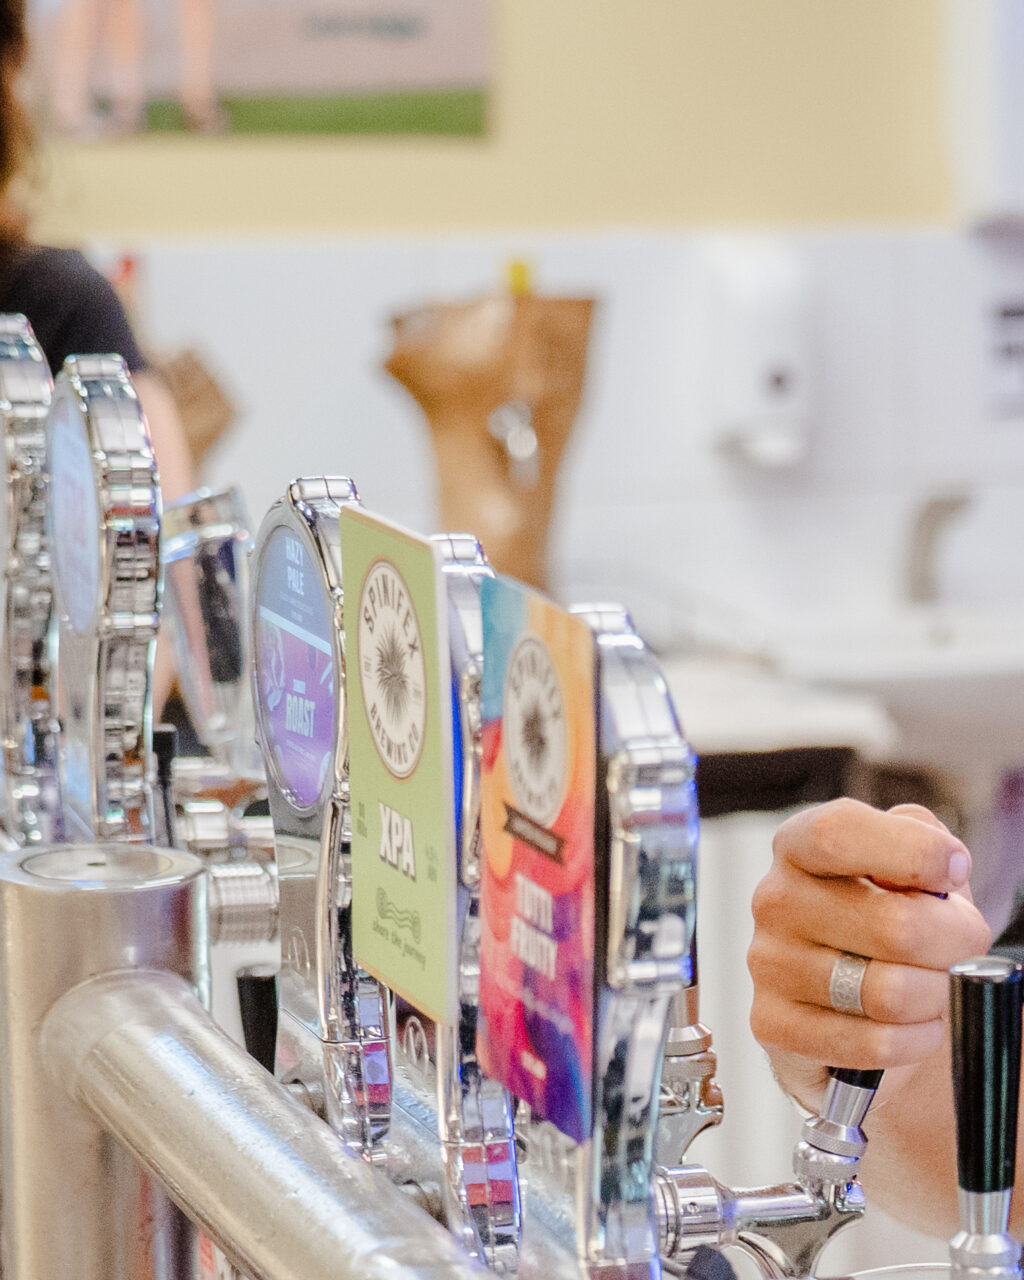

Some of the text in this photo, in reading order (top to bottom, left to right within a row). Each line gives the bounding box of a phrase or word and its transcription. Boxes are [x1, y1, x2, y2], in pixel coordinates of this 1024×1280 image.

[363, 573, 419, 659] SPINIFEX
[370, 702, 408, 766] BREWING
[378, 801, 417, 883] XPA
